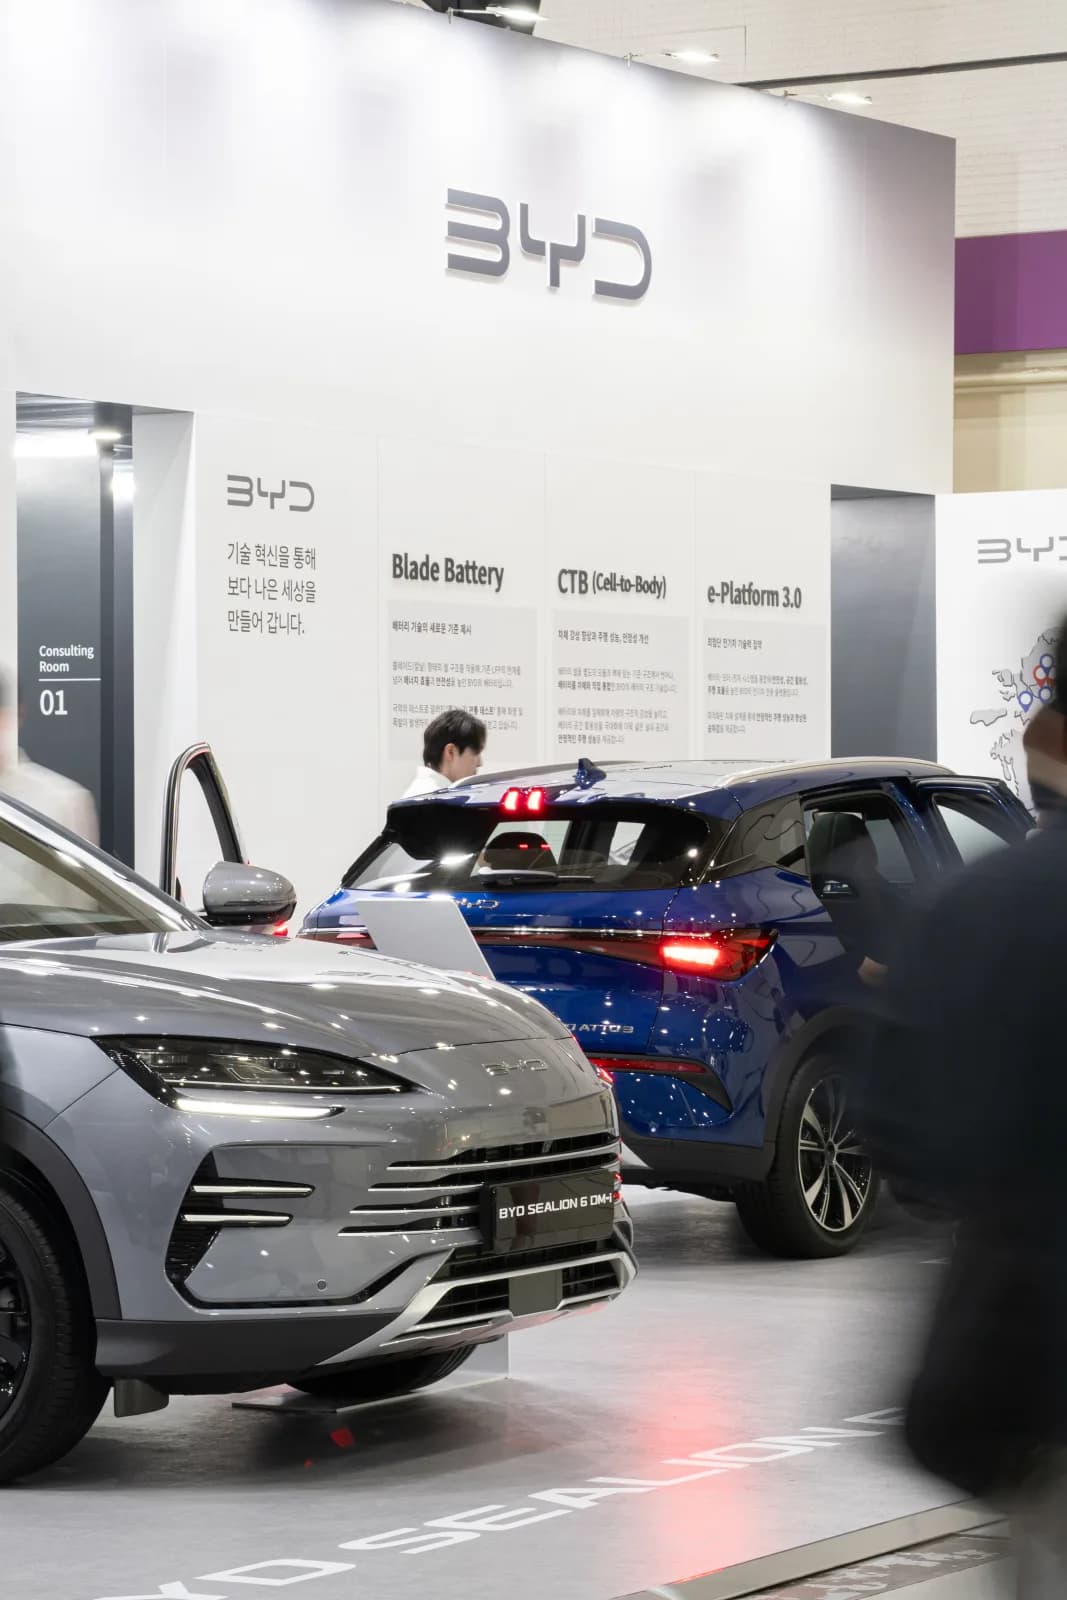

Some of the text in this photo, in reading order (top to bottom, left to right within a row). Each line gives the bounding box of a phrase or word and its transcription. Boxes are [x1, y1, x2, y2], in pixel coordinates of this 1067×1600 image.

[447, 187, 652, 301] BYD
[227, 474, 314, 512] BYD
[227, 541, 316, 570] 기술 혁신을 통해
[977, 536, 1067, 564] BY
[392, 552, 505, 593] Blade Battery
[557, 568, 667, 599] CTB (Cell-to-Body)
[227, 576, 316, 603] 보다 나은 세상을
[707, 581, 802, 609] e-Platform 3.0
[227, 609, 305, 636] 만들어 갑니다.
[392, 620, 410, 632] 배터리
[411, 621, 428, 633] 기술의
[430, 622, 446, 634] 새로운
[448, 623, 459, 635] 기준
[39, 644, 94, 660] Consulting
[39, 661, 70, 672] Room
[39, 689, 68, 716] 01
[499, 1205, 525, 1219] BYD
[527, 1198, 578, 1216] SEALION
[580, 1195, 588, 1208] 6
[337, 1426, 886, 1554] SEALION
